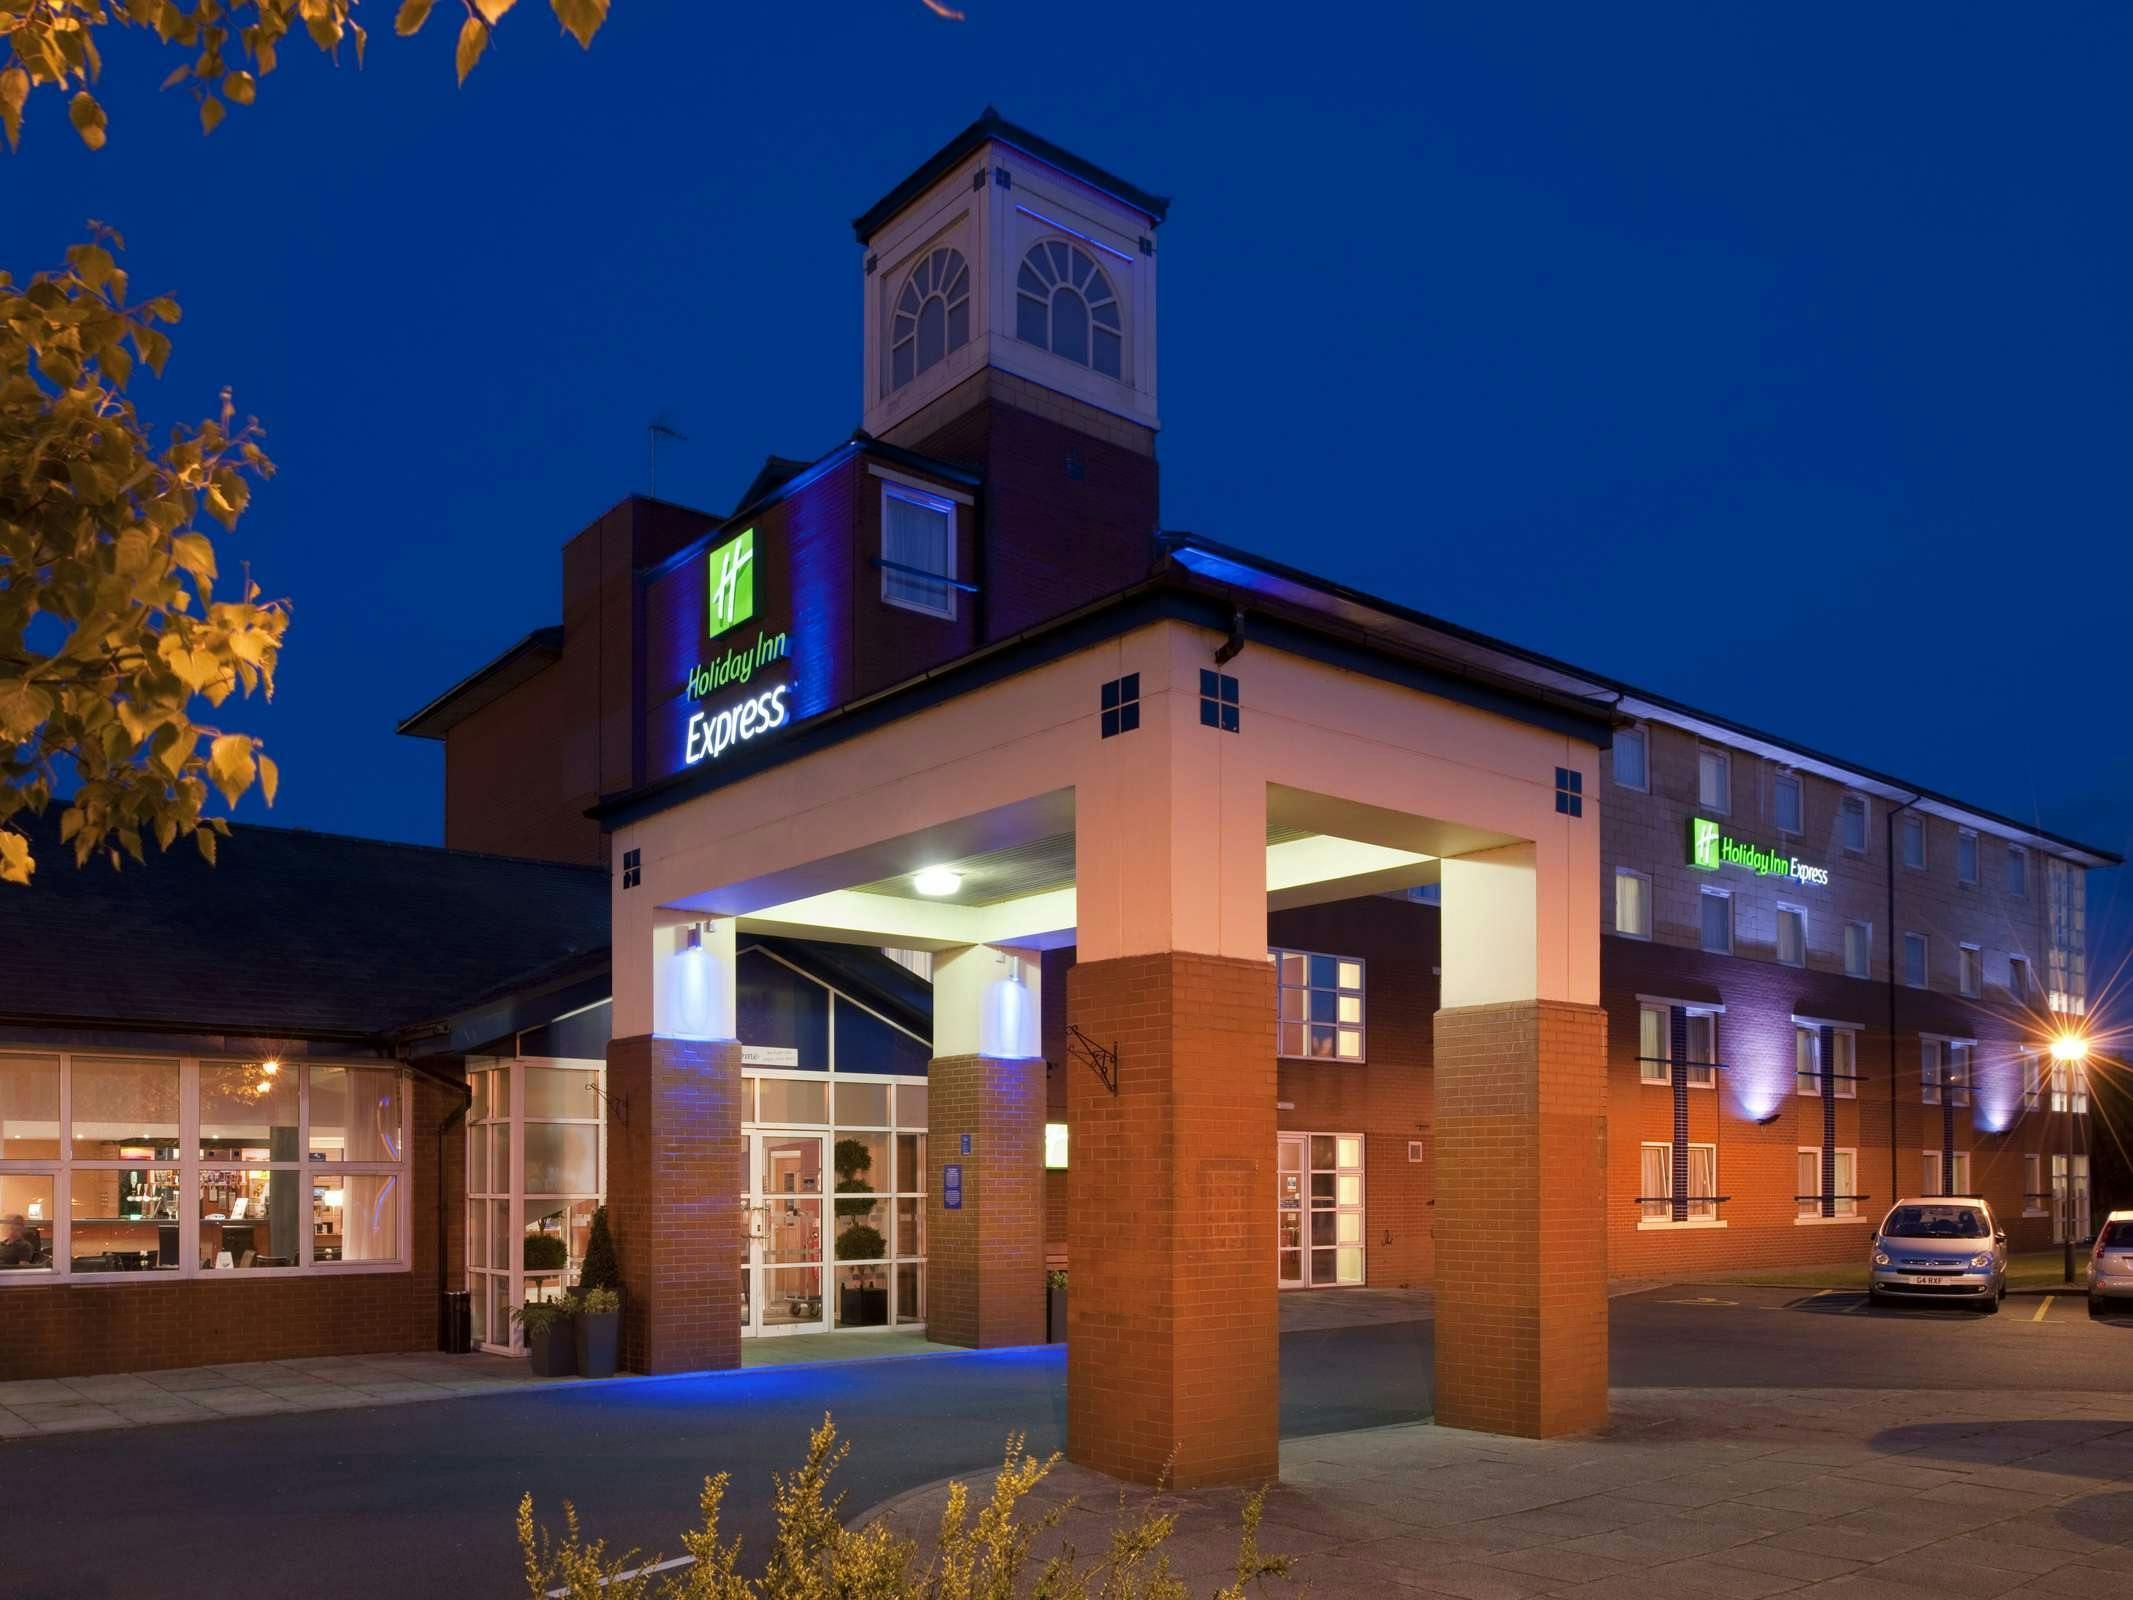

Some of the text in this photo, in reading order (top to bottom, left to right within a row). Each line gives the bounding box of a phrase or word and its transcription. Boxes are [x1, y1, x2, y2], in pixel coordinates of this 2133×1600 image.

[687, 631, 786, 701] Holiday Inn
[685, 685, 786, 765] Express
[1722, 837, 1828, 885] Holiday Inn Express
